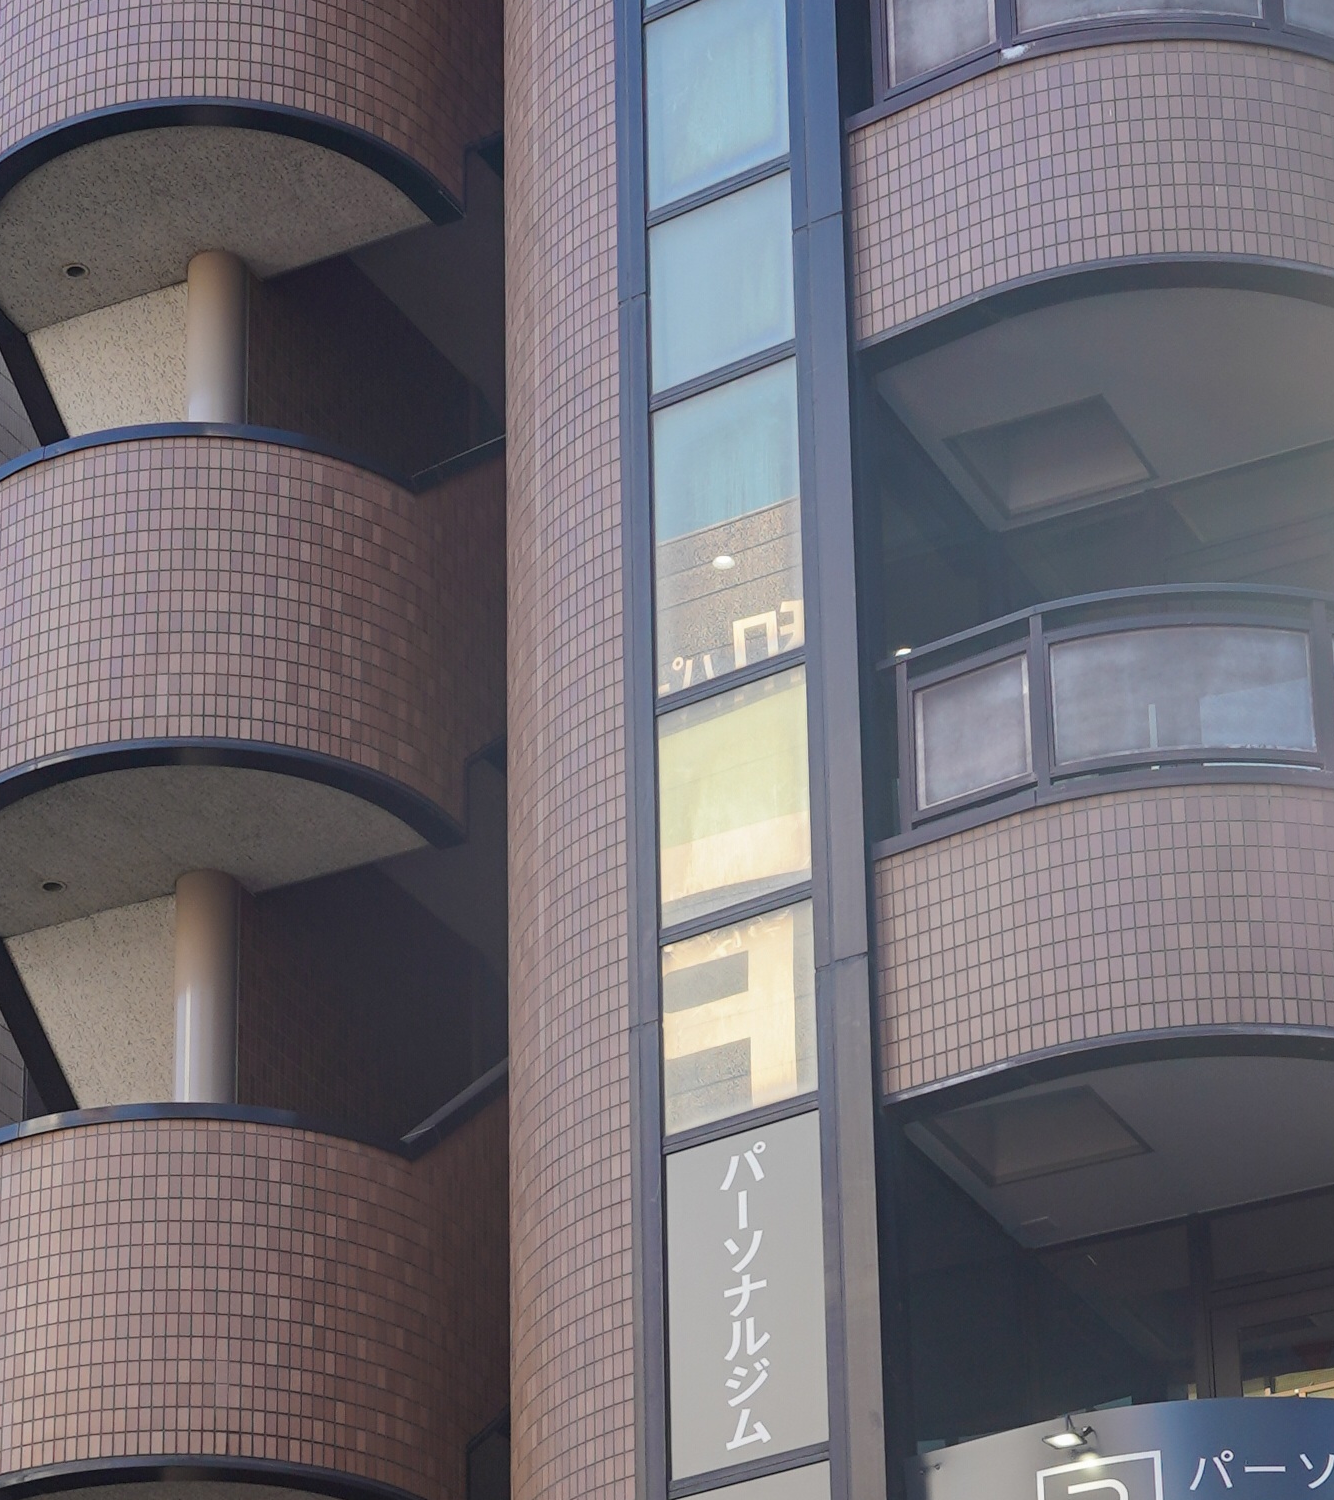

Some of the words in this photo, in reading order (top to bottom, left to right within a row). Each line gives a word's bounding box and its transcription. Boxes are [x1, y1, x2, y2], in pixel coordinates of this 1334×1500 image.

[720, 1140, 771, 1451] パーソナルジム
